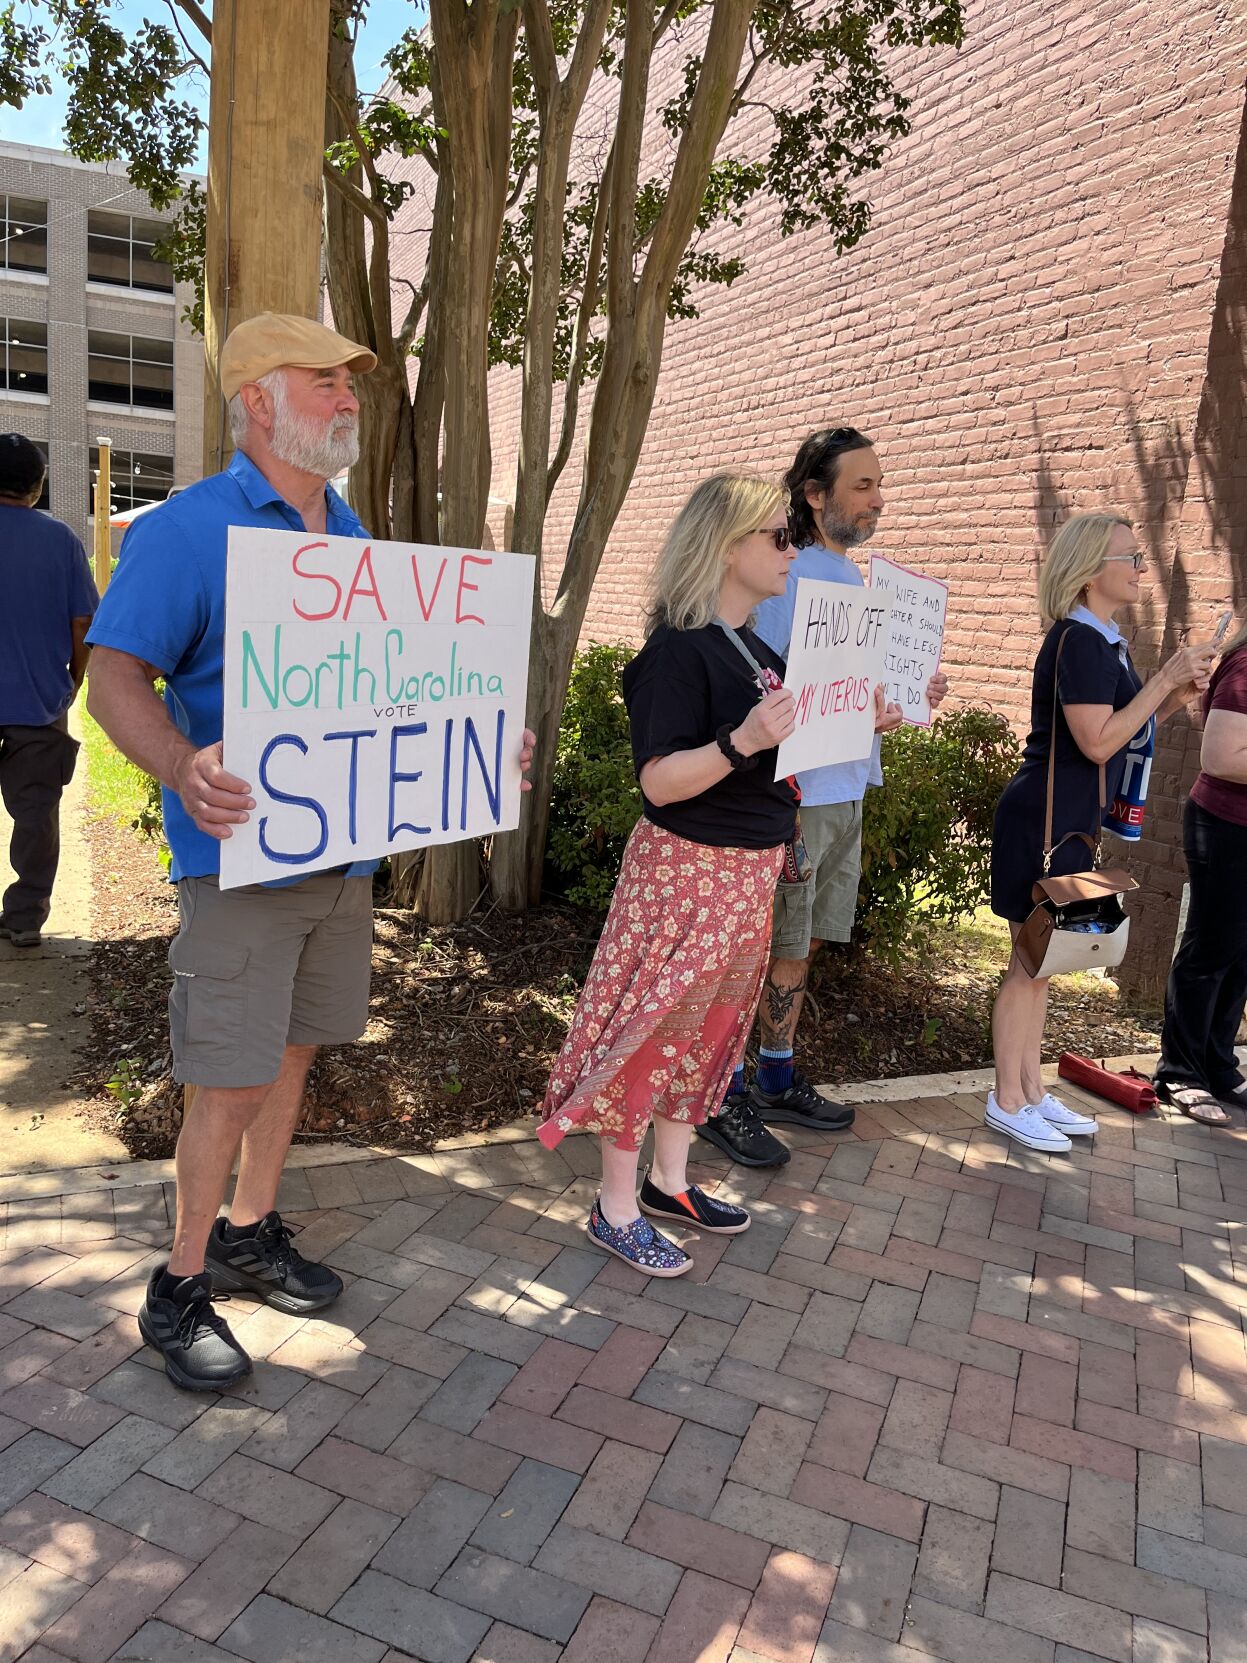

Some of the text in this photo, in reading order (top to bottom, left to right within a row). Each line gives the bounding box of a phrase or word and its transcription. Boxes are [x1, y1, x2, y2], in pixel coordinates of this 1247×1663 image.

[292, 541, 493, 625] SAVE
[876, 576, 940, 613] MY WIFE AND
[804, 597, 885, 650] HANDS OFF
[891, 631, 938, 656] HAVE LESS
[919, 618, 944, 637] SHOULD
[241, 624, 504, 710] North Carolina
[373, 703, 418, 719] VOTE
[793, 676, 870, 726] MY UTERUS
[893, 683, 902, 701] I
[907, 686, 921, 705] DO
[258, 708, 506, 865] STEIN
